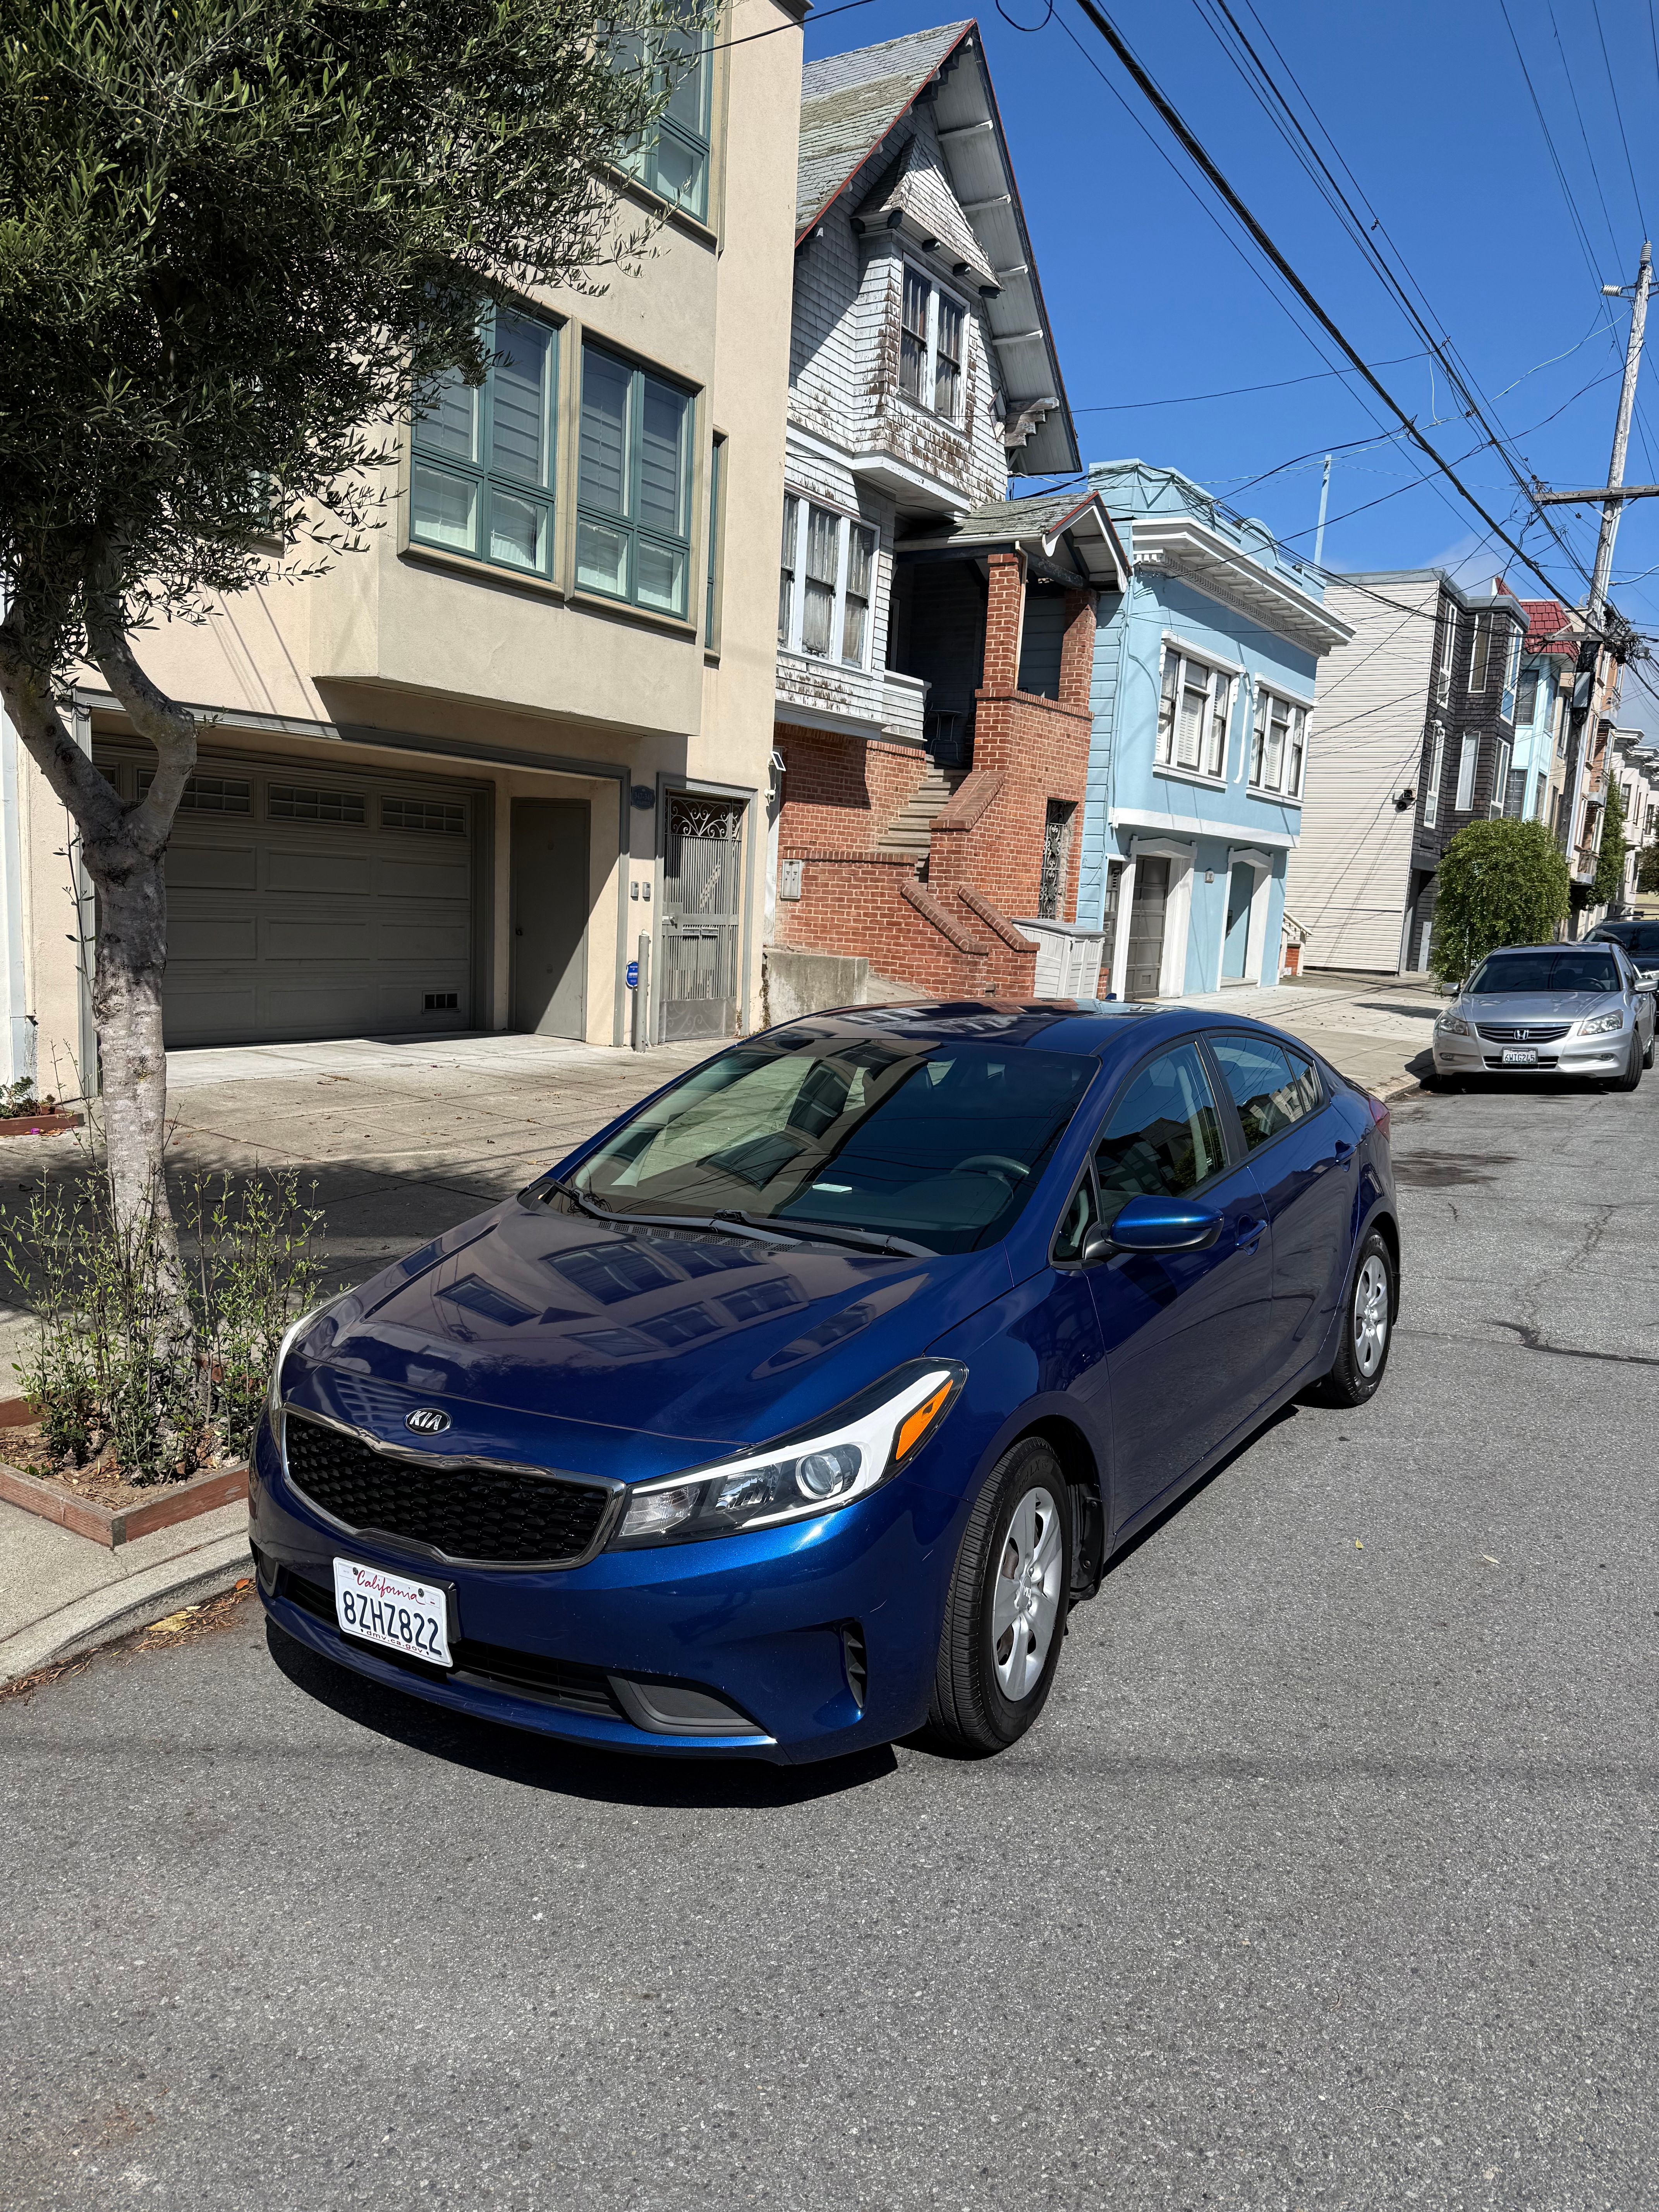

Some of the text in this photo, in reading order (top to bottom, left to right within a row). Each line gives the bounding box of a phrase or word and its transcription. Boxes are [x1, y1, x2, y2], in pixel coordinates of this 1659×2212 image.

[409, 1411, 442, 1431] KIA
[1030, 1460, 1039, 1477] LX
[357, 1570, 425, 1605] California
[343, 1590, 442, 1656] 8ZHZ822
[366, 1630, 422, 1653] dmv.ca.gov
